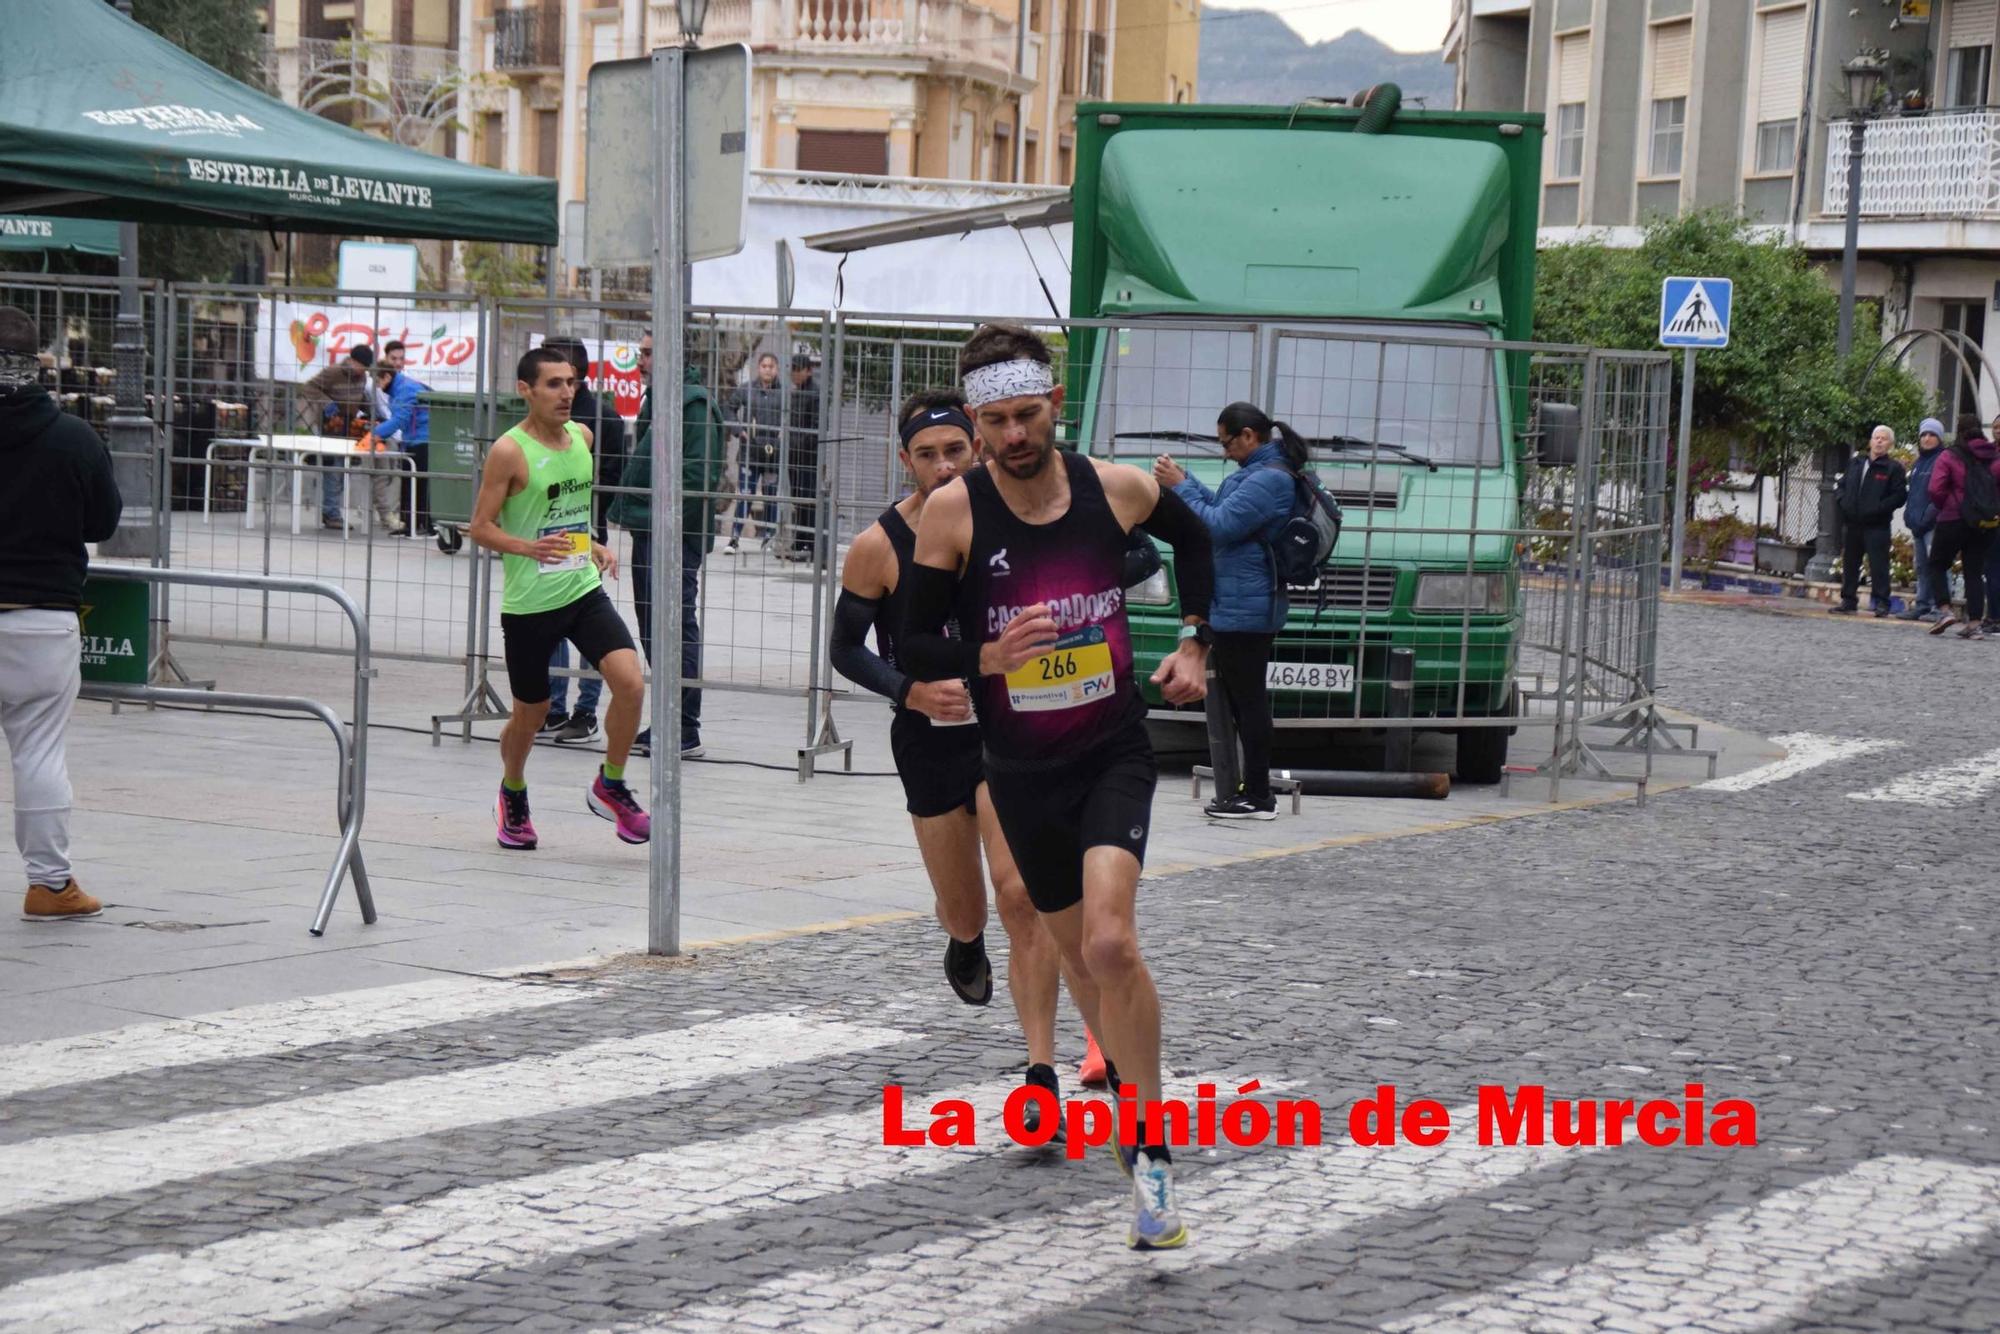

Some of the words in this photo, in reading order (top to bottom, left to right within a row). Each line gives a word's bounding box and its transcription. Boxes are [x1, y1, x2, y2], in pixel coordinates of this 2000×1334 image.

[187, 158, 311, 192] ESTRELLA
[313, 177, 329, 190] DE
[330, 174, 433, 208] LEVANTE
[288, 193, 321, 204] MURCIA
[1040, 652, 1077, 680] 266
[1270, 666, 1320, 687] 4648
[1325, 668, 1350, 688] BY
